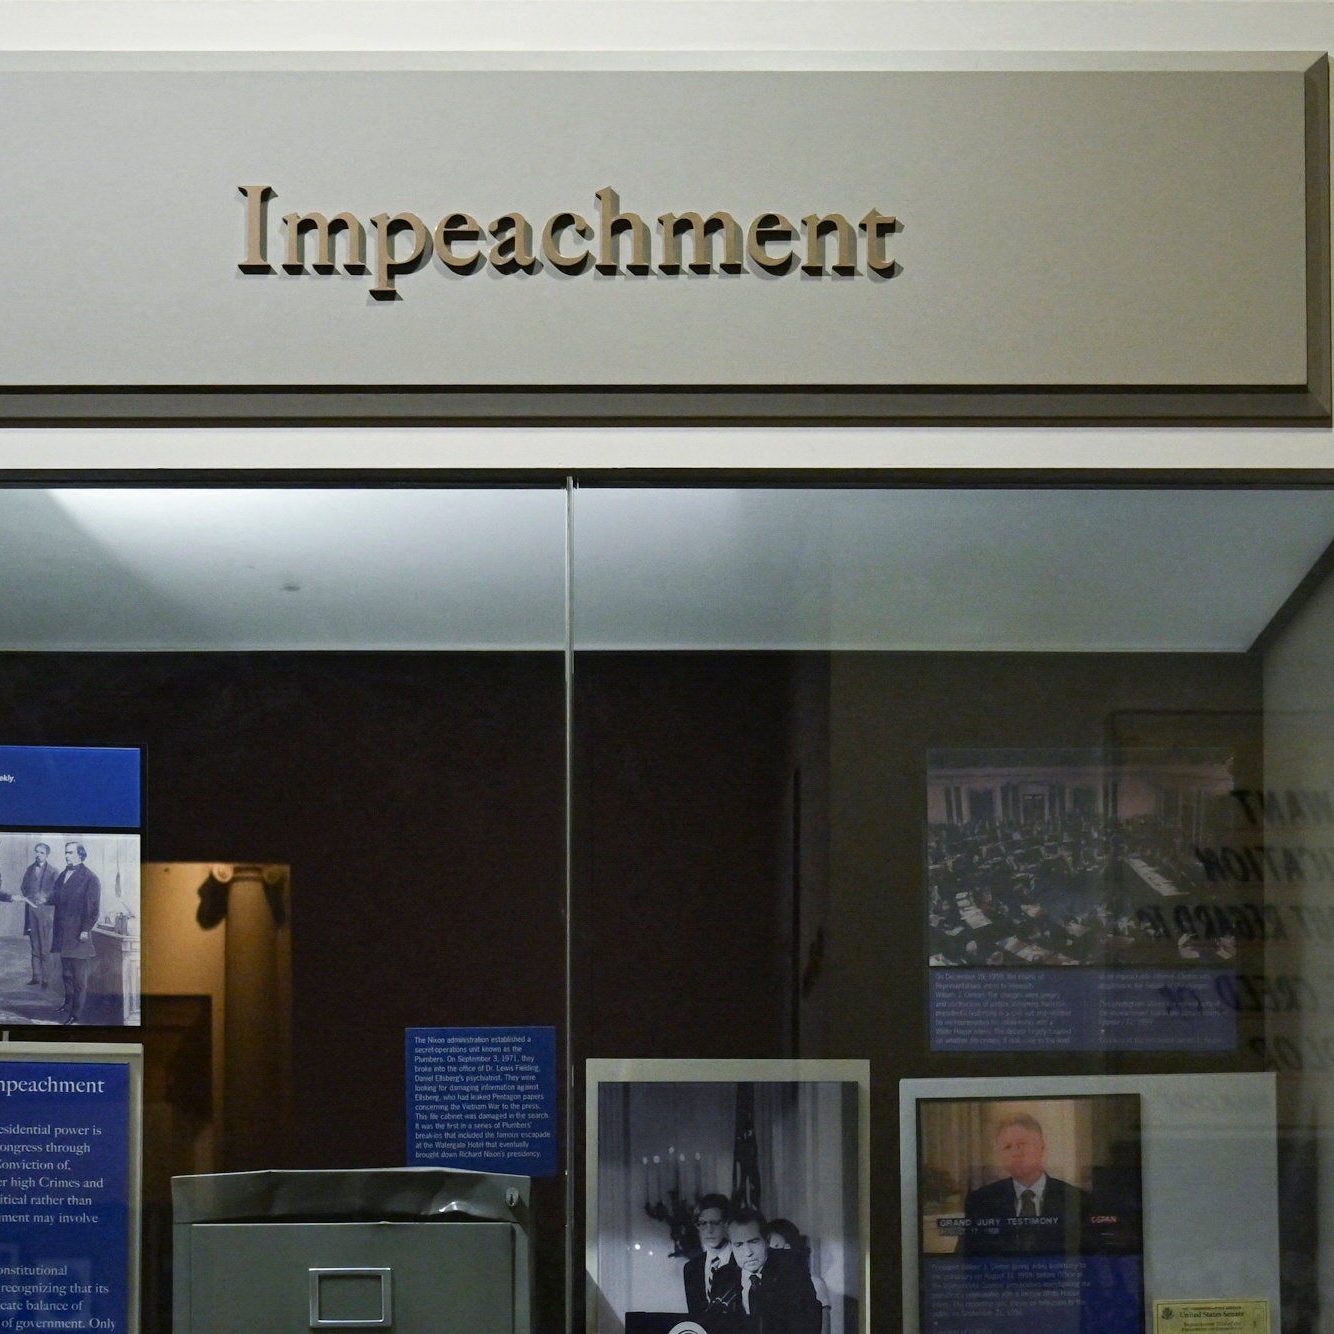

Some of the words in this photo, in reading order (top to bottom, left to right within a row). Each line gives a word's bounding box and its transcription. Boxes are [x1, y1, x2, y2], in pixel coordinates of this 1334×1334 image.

[237, 185, 896, 299] Impeachment
[446, 1035, 489, 1043] administration
[457, 1055, 490, 1063] September
[521, 1054, 535, 1063] they
[54, 1127, 89, 1138] power
[92, 1124, 102, 1135] is
[45, 1141, 91, 1156] through
[10, 1176, 35, 1190] high
[38, 1176, 80, 1187] Crimes
[83, 1176, 103, 1188] and
[30, 1193, 64, 1204] rather
[67, 1193, 92, 1204] than
[33, 1214, 55, 1226] may
[58, 1211, 98, 1222] involve
[940, 1218, 971, 1227] GRAND
[977, 1218, 1000, 1226] JURY
[1007, 1217, 1059, 1225] TESTIMONY
[1, 1316, 13, 1327] of
[88, 1317, 115, 1332] Only
